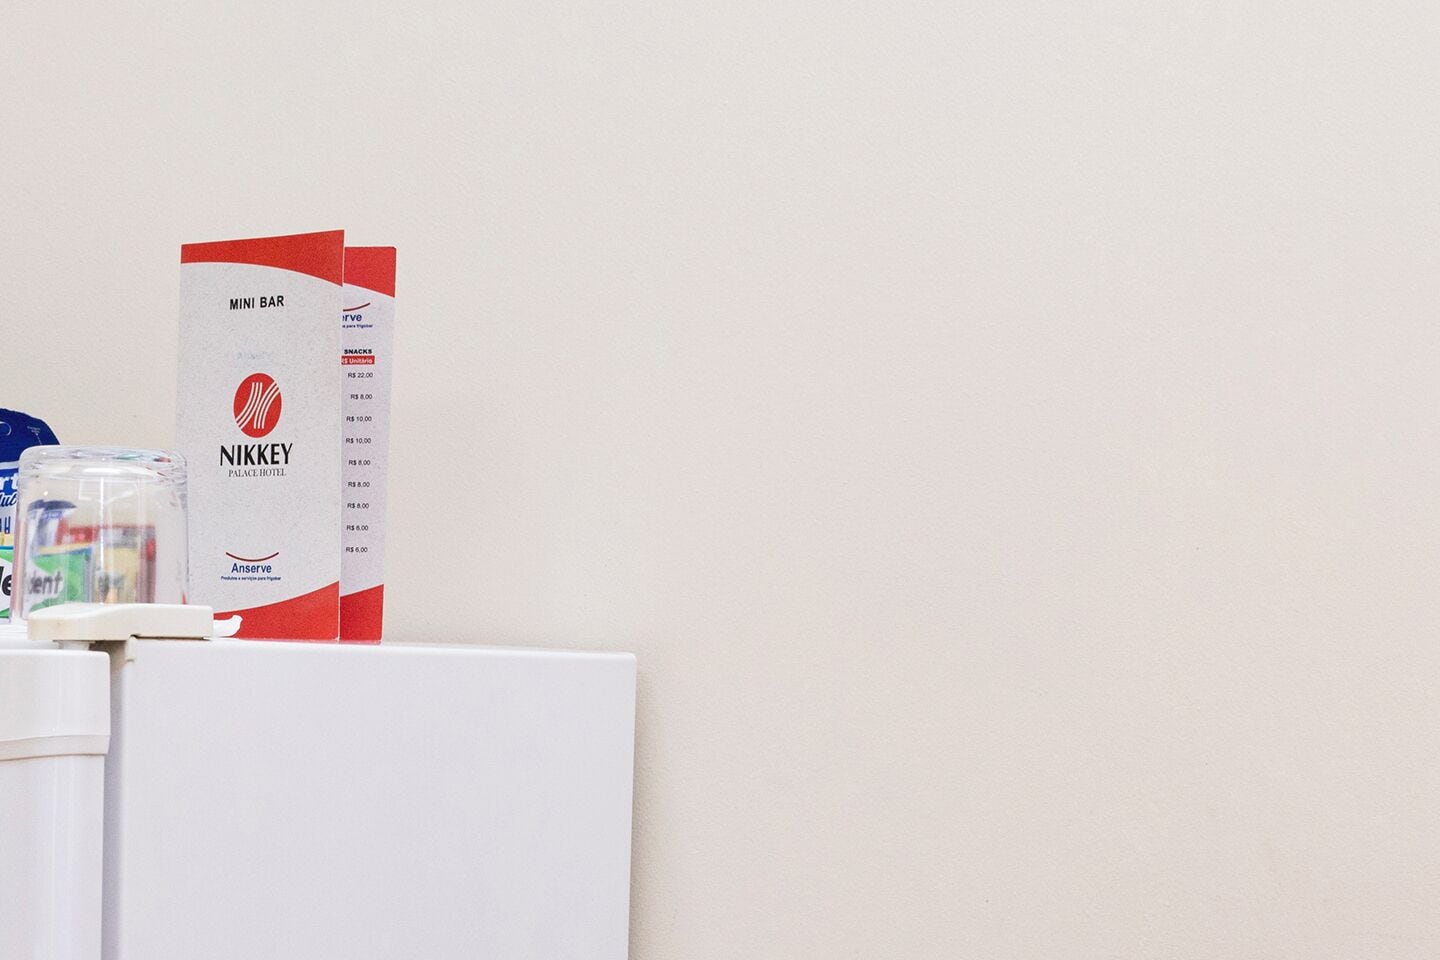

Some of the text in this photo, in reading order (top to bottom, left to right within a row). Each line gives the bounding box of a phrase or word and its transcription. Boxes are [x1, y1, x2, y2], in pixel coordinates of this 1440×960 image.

[229, 295, 285, 310] MINI BAR
[220, 442, 293, 466] NIKKEY
[228, 468, 287, 477] PALACE HOTEL
[231, 562, 272, 573] Anserve
